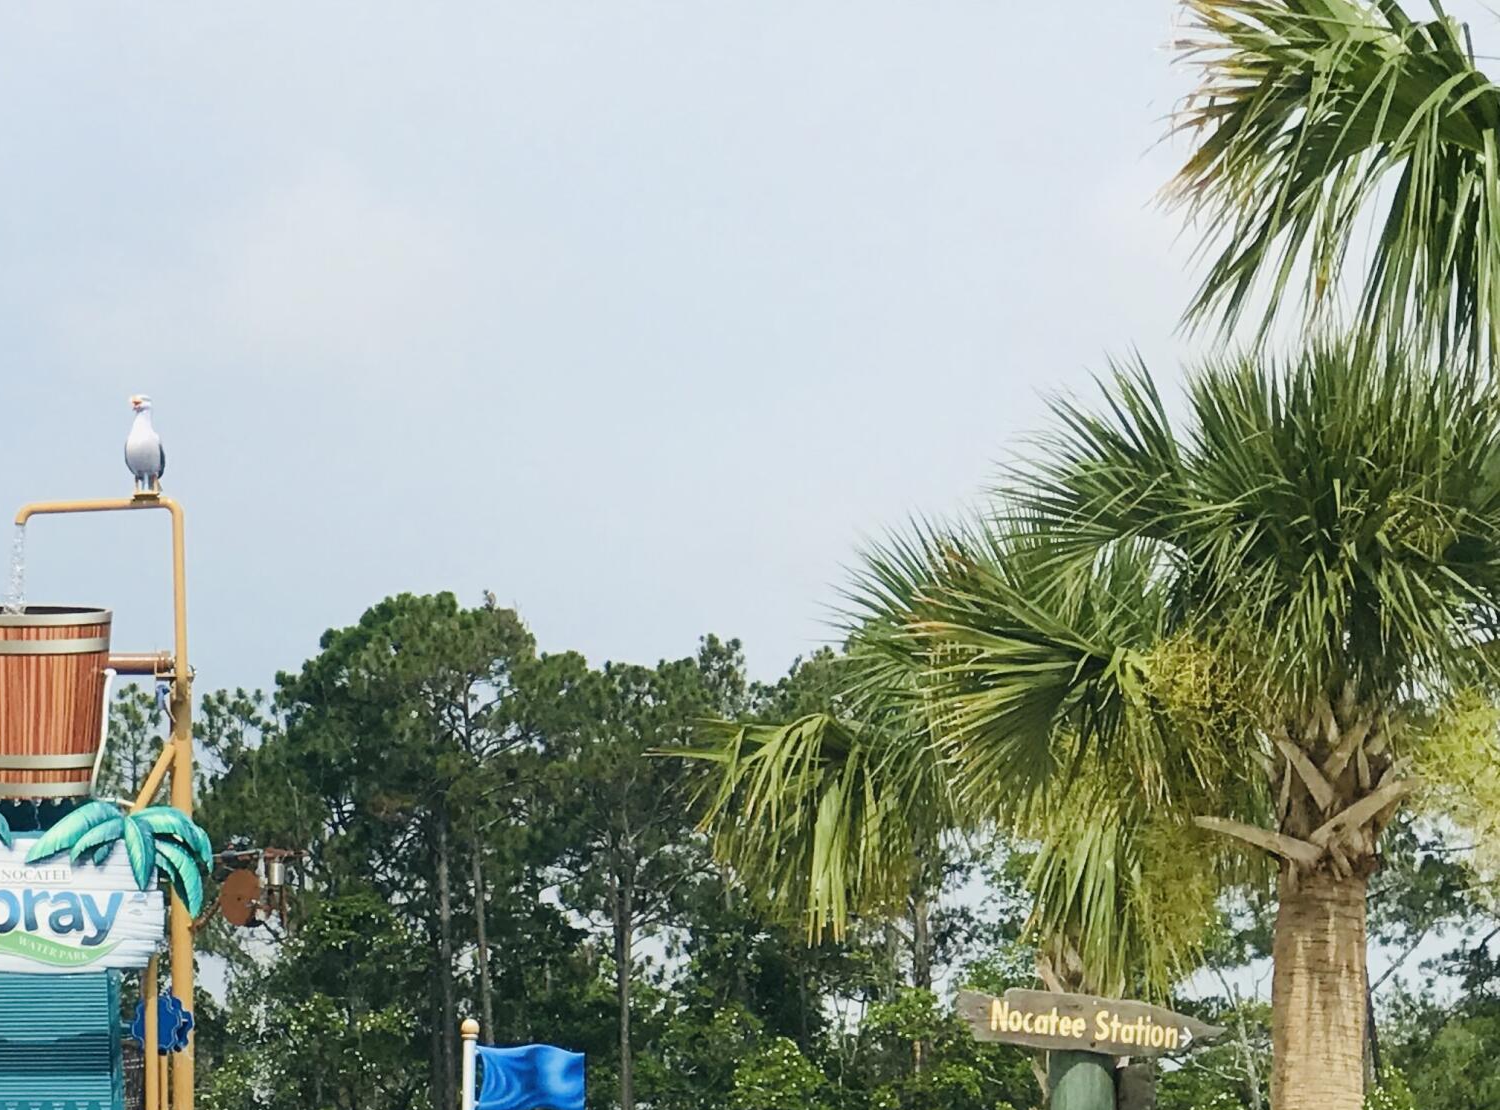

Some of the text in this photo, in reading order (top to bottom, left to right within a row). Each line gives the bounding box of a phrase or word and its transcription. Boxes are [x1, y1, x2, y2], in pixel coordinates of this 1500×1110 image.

[1, 869, 71, 881] NOCATEE
[990, 1000, 1179, 1049] Nocatee Station
